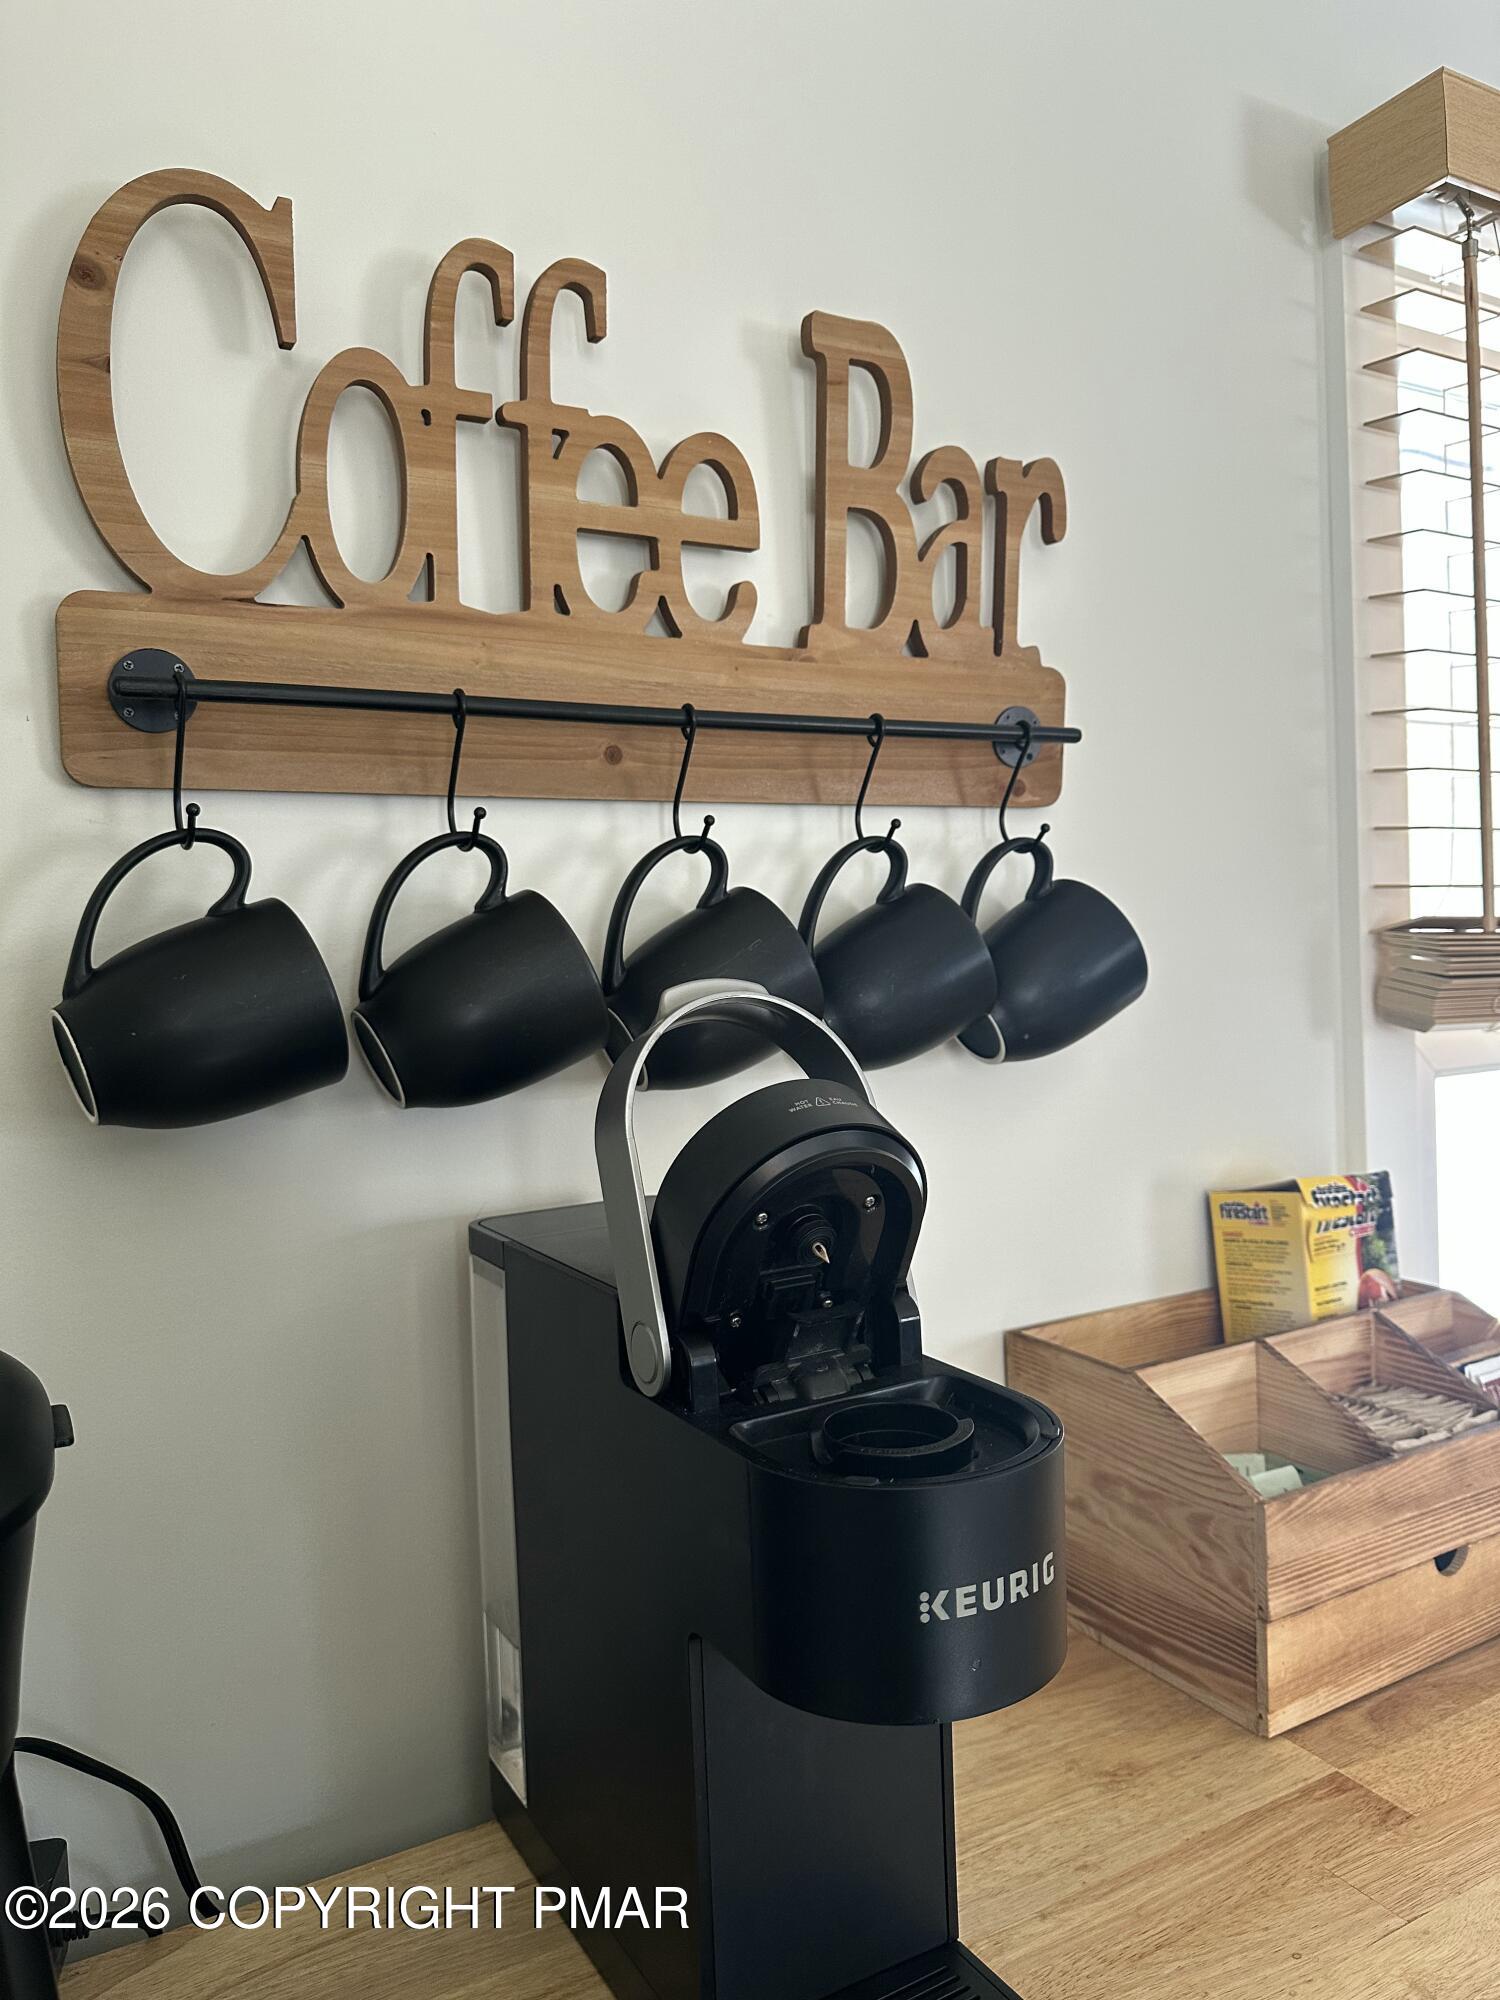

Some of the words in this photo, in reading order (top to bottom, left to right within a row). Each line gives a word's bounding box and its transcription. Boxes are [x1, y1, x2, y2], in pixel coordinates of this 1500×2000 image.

[57, 168, 760, 646] Coffee
[800, 310, 1067, 660] Bar
[919, 1551, 1055, 1624] KEURIG
